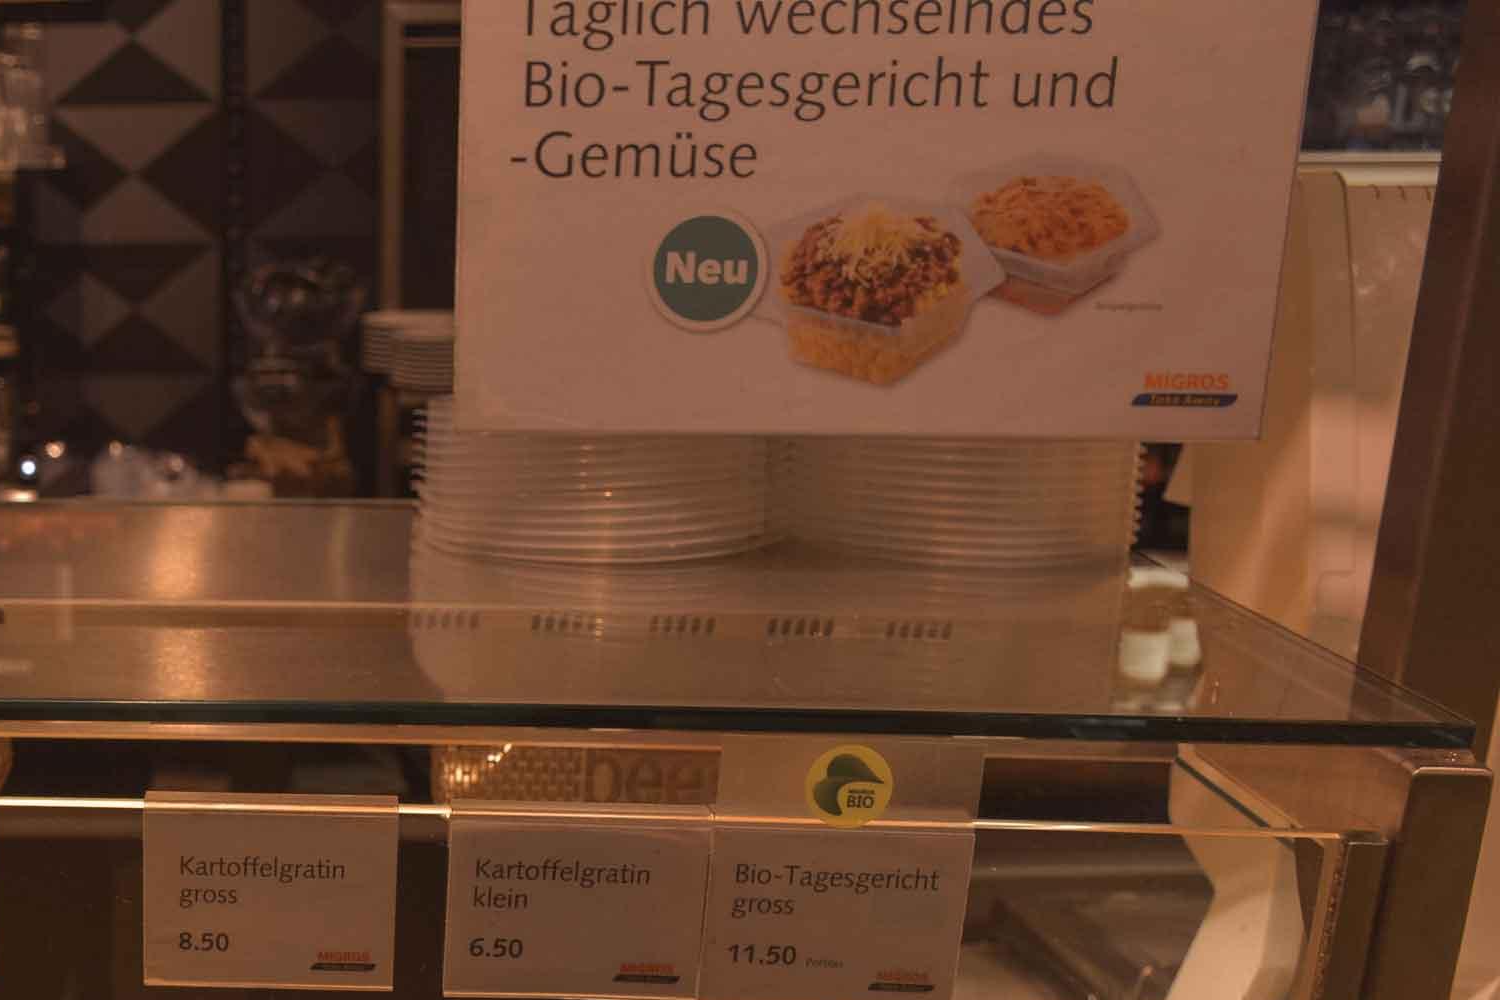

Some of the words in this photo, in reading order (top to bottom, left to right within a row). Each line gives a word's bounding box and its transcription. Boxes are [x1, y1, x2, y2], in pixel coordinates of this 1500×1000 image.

[737, 0, 1094, 36] wechselndes
[524, 56, 989, 121] Bio-Tagesgericht
[1011, 56, 1119, 107] und
[511, 130, 758, 178] -Gemüse
[664, 249, 750, 286] Neu
[1143, 371, 1229, 391] MIGROS
[846, 794, 875, 809] BIO
[179, 855, 346, 884] Kartoffelgratin
[473, 858, 651, 888] Kartoffelgratin
[734, 863, 941, 892] Bio-Tagesgericht
[179, 887, 238, 907] gross
[472, 886, 529, 909] klein
[731, 897, 796, 920] gross
[178, 932, 230, 953] 8.50
[468, 937, 524, 958] 6.50
[727, 943, 797, 966] 11.50
